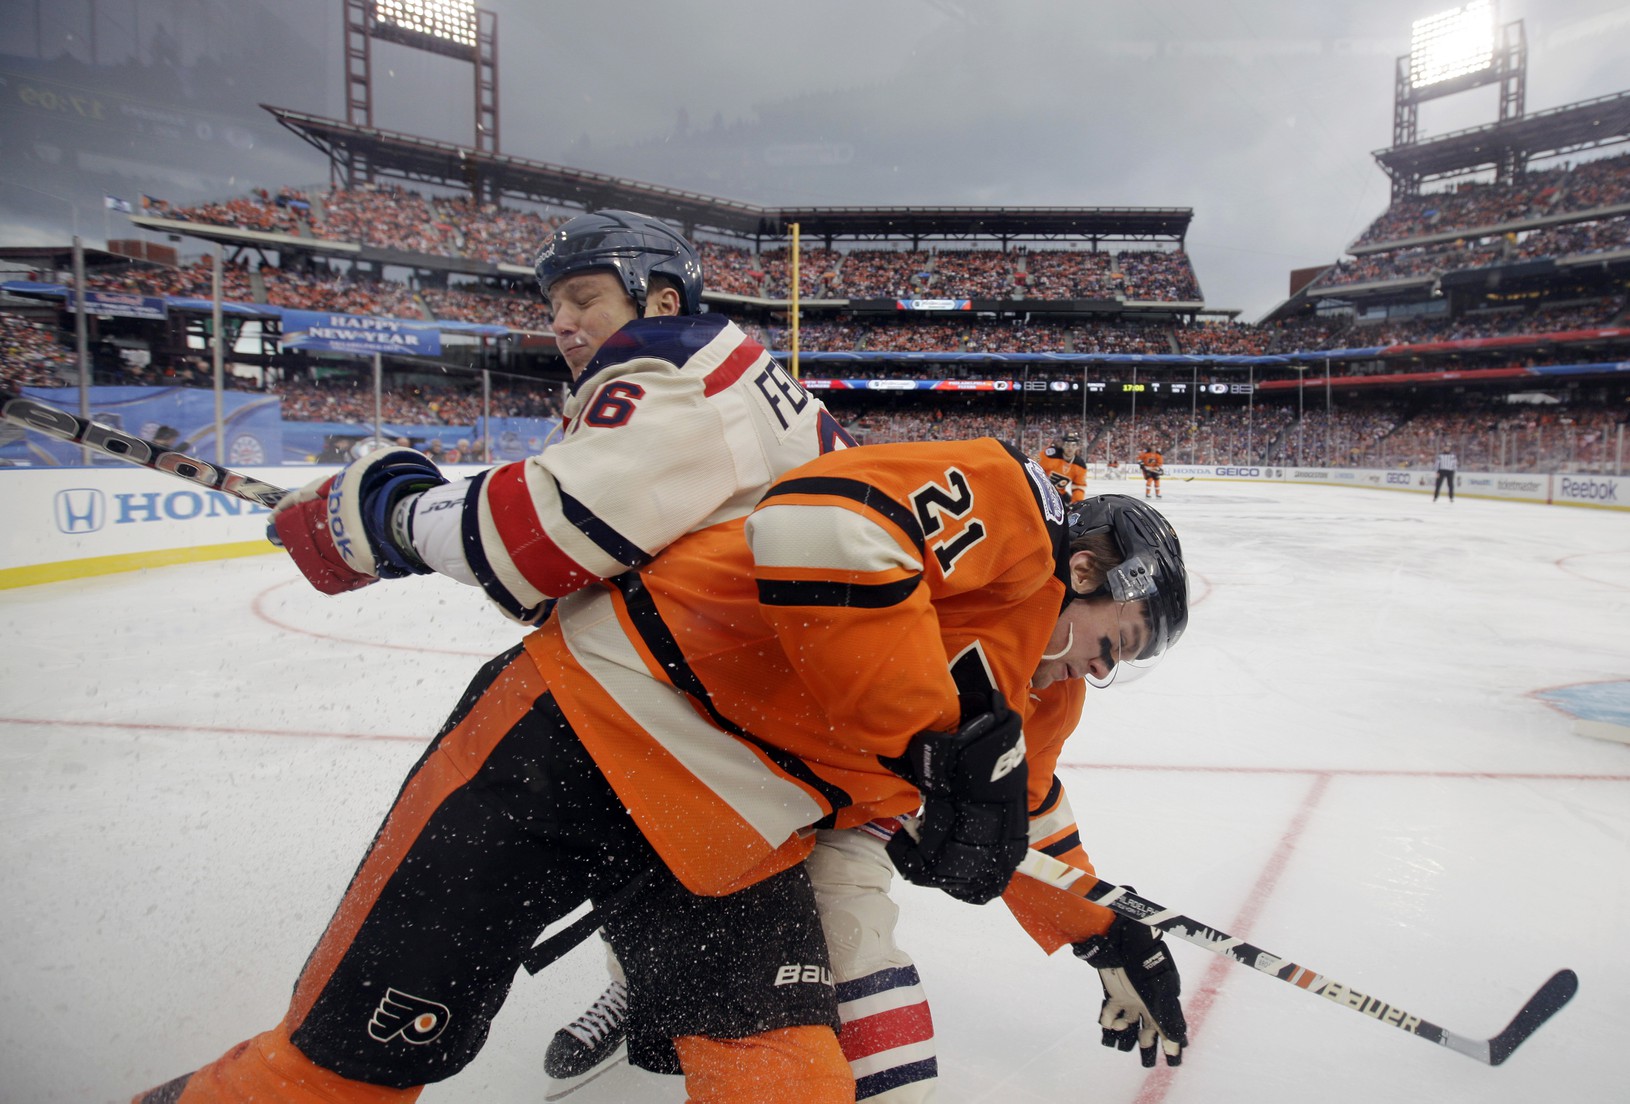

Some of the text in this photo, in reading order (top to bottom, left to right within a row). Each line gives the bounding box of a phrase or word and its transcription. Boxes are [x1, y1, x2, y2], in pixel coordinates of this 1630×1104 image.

[330, 316, 400, 332] HAPPY
[309, 327, 419, 346] NEW YEAR
[1215, 467, 1260, 477] GEICO
[1386, 472, 1411, 485] GEICO
[1561, 477, 1618, 501] Reebok
[908, 466, 987, 579] 21
